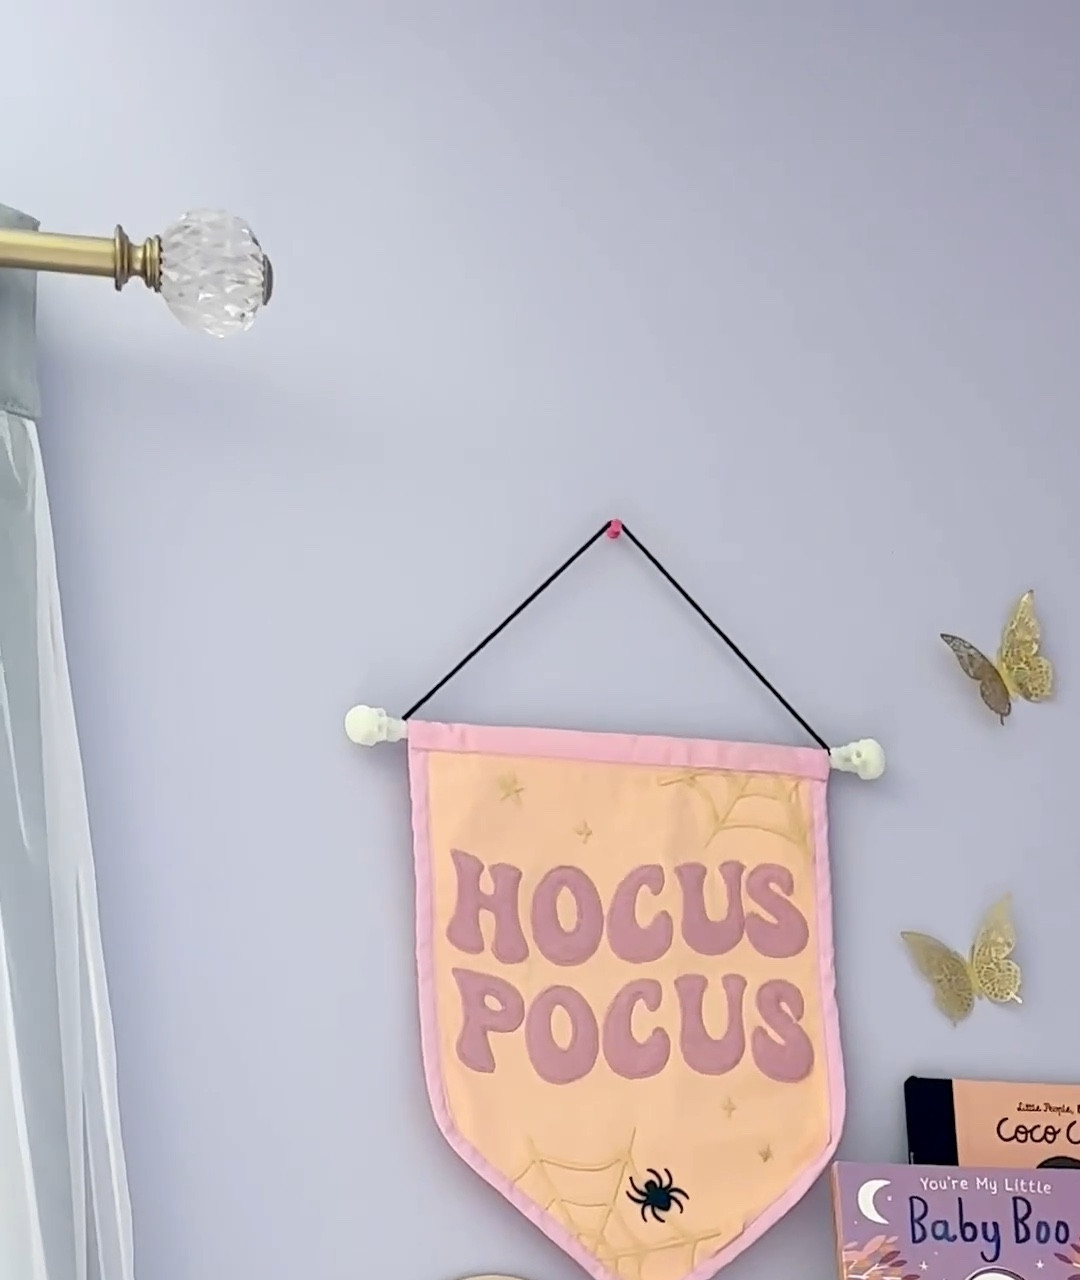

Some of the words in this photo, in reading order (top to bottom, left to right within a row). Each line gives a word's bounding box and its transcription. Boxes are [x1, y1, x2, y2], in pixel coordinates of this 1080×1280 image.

[446, 848, 810, 967] HOCUS
[451, 967, 815, 1085] POCUS
[996, 1117, 1061, 1144] Coco
[919, 1175, 968, 1192] You're
[976, 1177, 998, 1194] My
[1004, 1177, 1052, 1194] Little
[908, 1195, 1001, 1263] Baby
[1012, 1195, 1071, 1245] Boo
